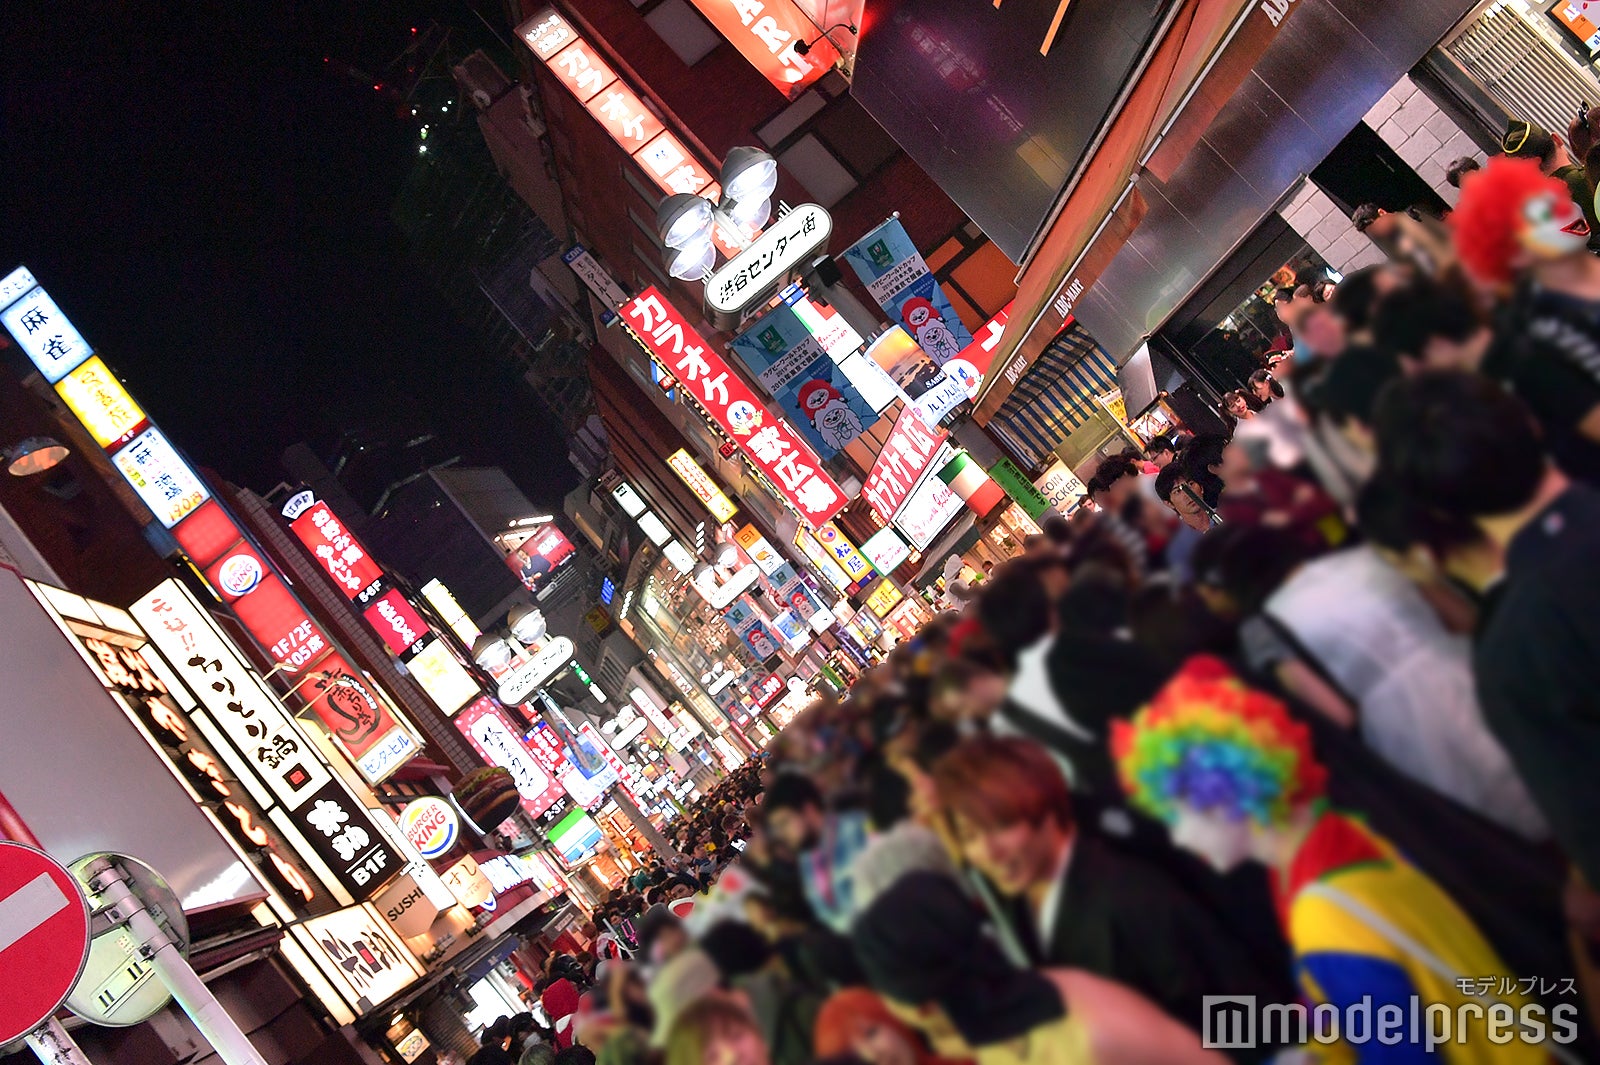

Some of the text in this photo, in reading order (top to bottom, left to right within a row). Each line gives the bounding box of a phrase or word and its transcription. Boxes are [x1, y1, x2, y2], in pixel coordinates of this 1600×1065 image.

[720, 211, 817, 304] 渋谷センター街
[870, 255, 917, 290] ラグビーワールドカップ
[20, 305, 72, 361] 麻雀
[630, 293, 731, 406] カラオケ
[762, 337, 812, 379] ラグビーワールドカップ
[1040, 474, 1063, 496] COIN
[311, 508, 364, 564] お好み焼
[740, 530, 757, 544] B1
[231, 564, 254, 591] KING
[834, 542, 865, 573] 松屋
[270, 618, 313, 659] 1F/2F
[411, 639, 426, 655] 4F
[363, 734, 411, 775] センタービル
[407, 803, 440, 844] BURGER
[413, 810, 447, 852] KING
[350, 851, 391, 888] B1F
[448, 863, 478, 888] すし
